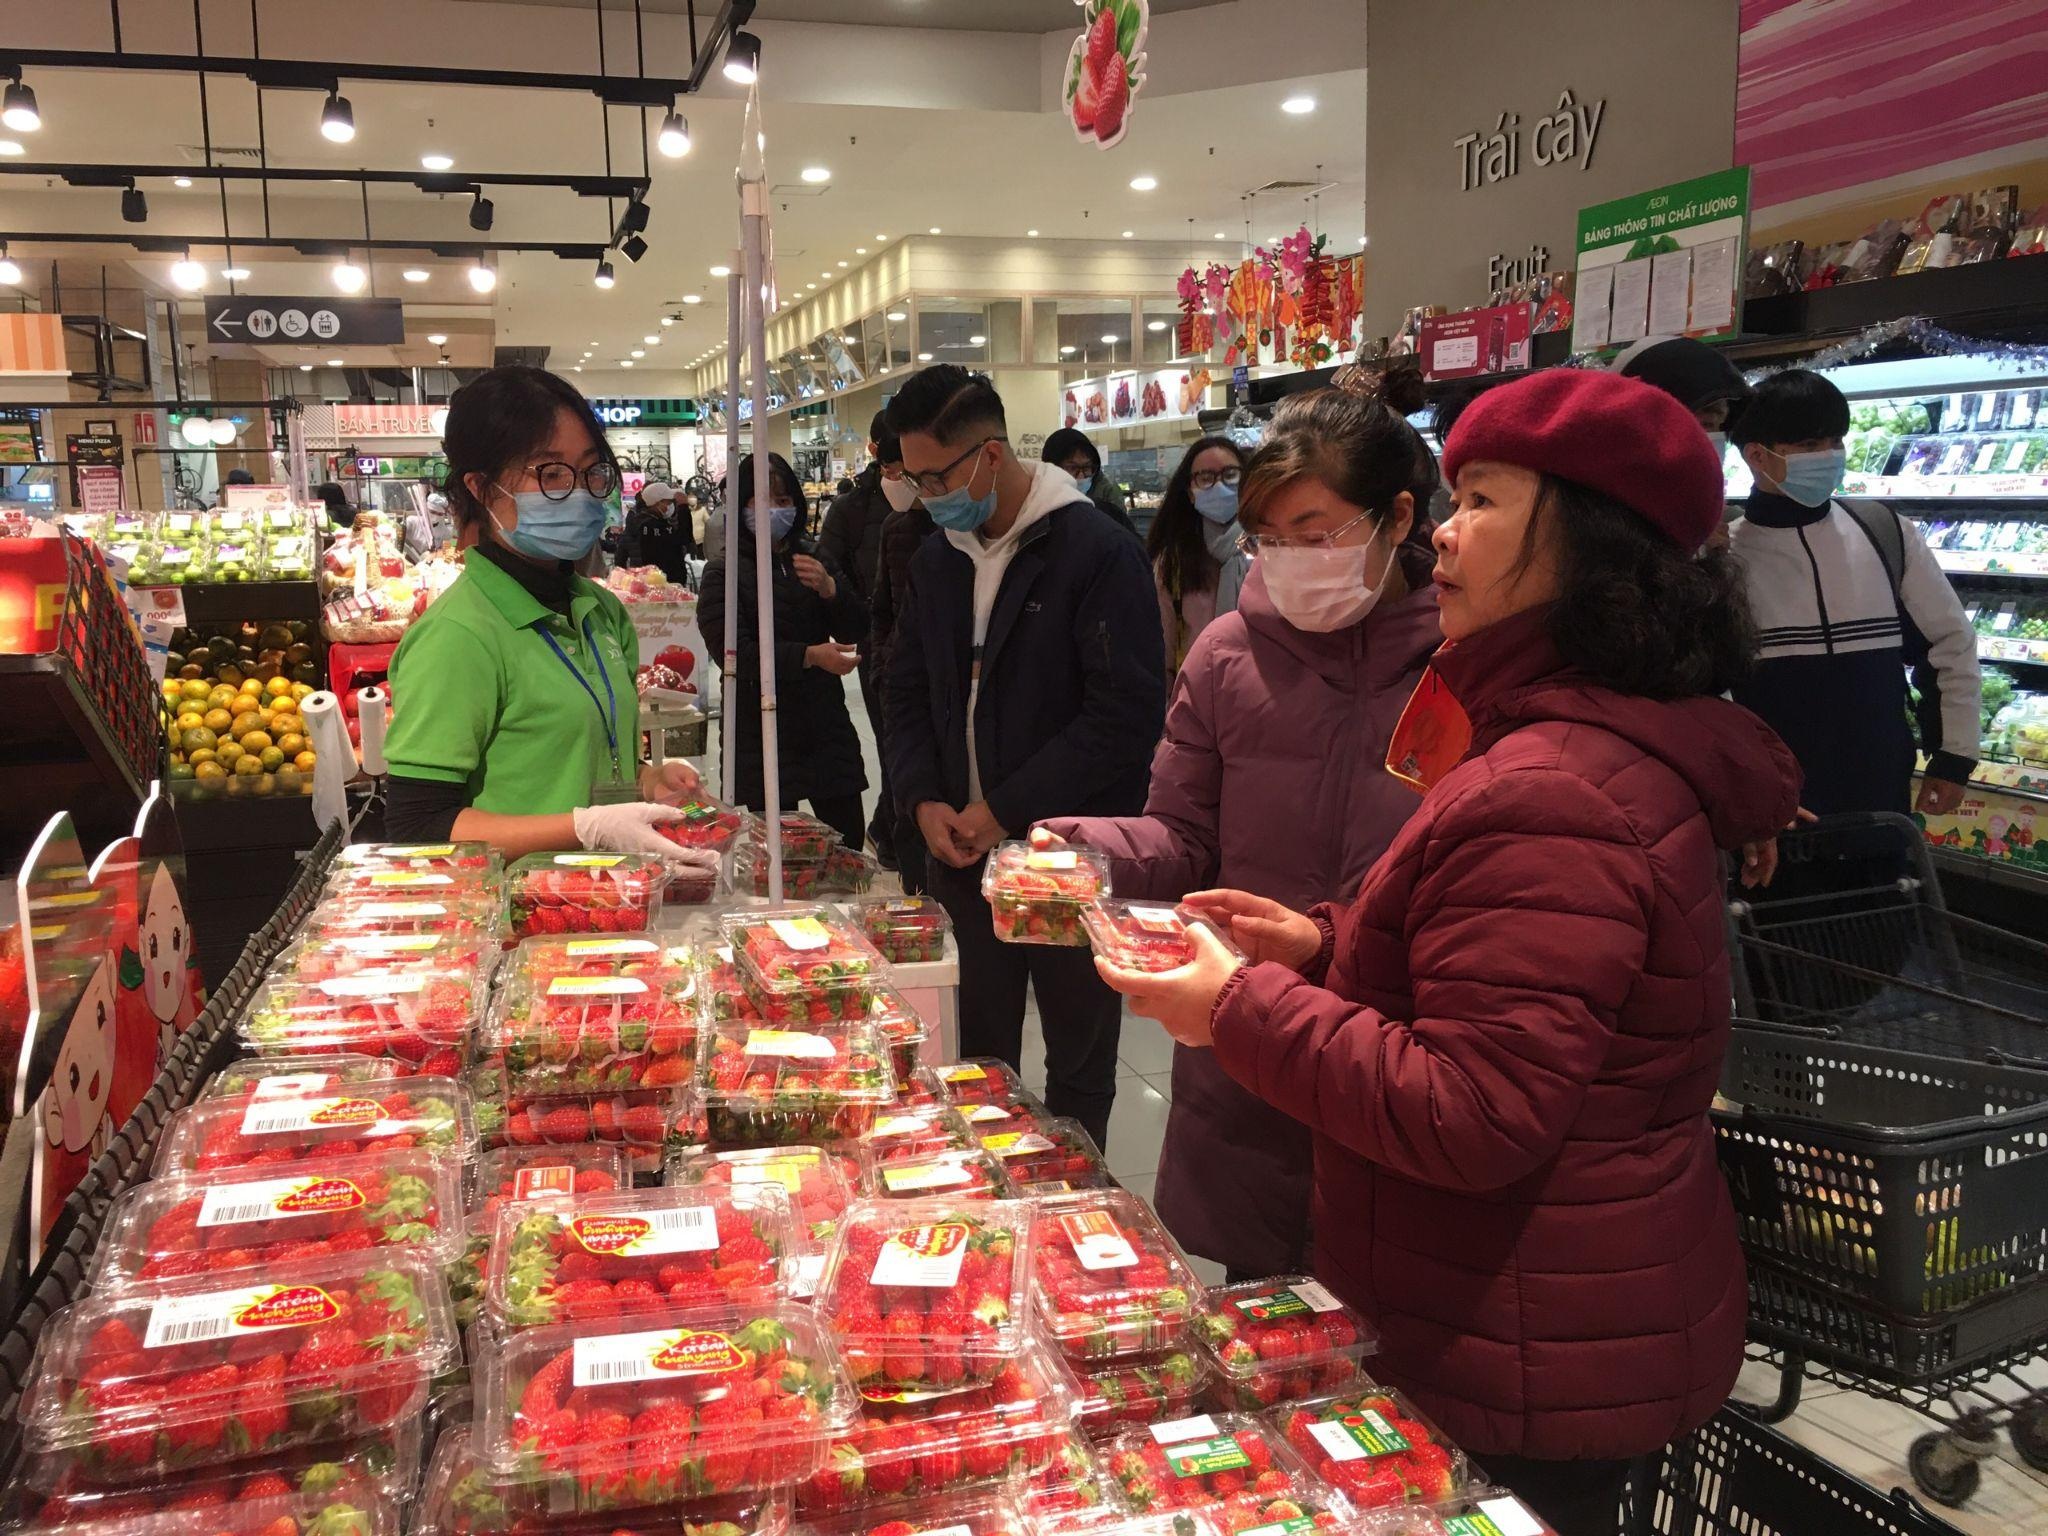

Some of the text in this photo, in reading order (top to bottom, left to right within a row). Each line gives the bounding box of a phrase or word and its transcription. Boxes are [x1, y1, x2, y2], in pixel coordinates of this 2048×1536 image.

[1453, 89, 1606, 191] Trái cây
[1584, 195, 1738, 244] BẢNG THÔNG TIN CHẤT LƯỢNG
[1488, 244, 1550, 293] Fruit
[338, 415, 380, 433] BÁNH
[295, 1186, 353, 1200] Korean
[583, 1232, 637, 1243] Korean
[257, 1293, 324, 1311] Korean
[669, 1341, 730, 1356] Korean
